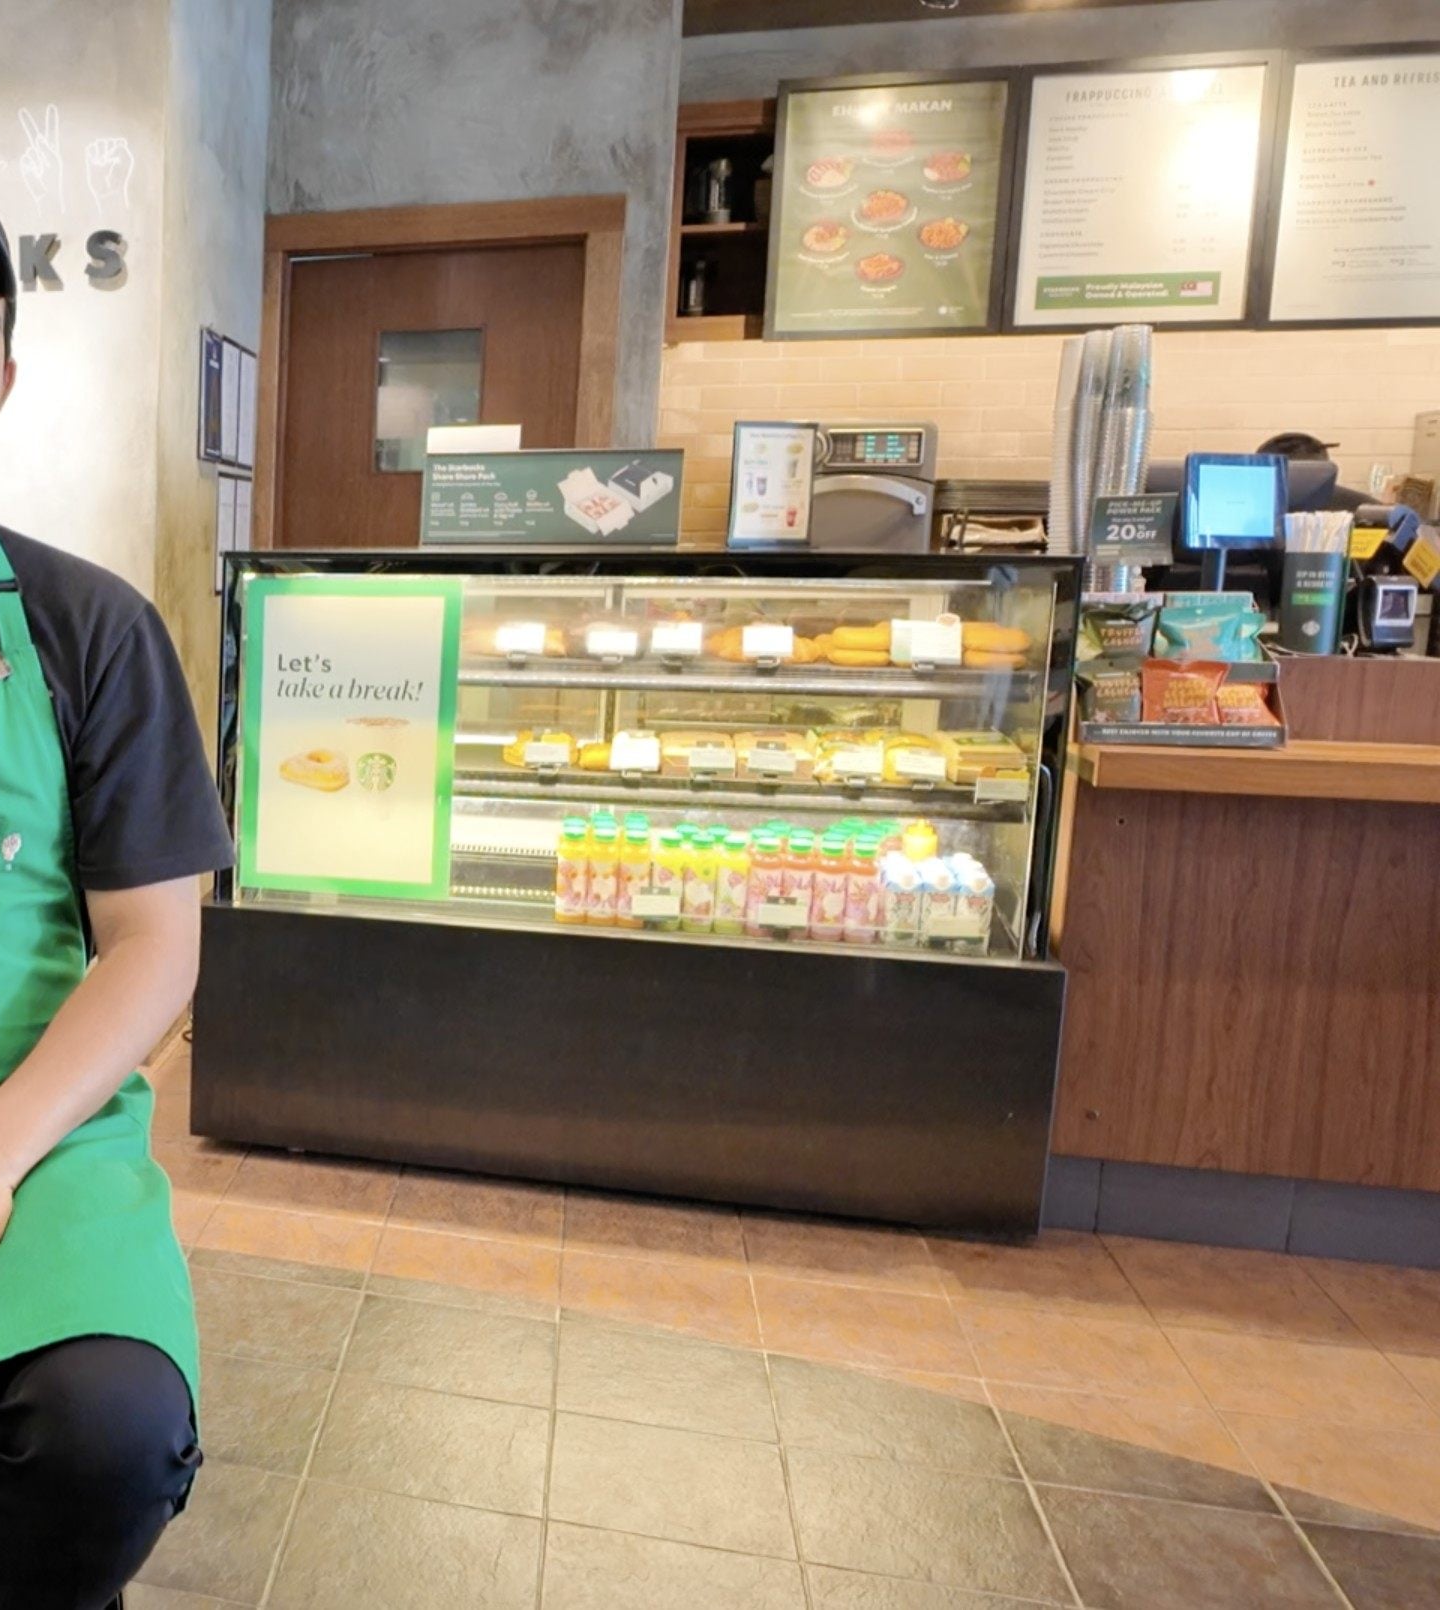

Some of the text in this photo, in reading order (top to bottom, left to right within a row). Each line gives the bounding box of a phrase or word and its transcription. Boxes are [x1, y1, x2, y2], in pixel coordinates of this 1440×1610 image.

[1333, 76, 1356, 88] TEA
[1361, 74, 1388, 86] AND
[894, 99, 953, 114] MAKAN
[1136, 530, 1157, 540] OFF
[277, 653, 332, 672] Let's
[277, 677, 424, 701] take a break!
